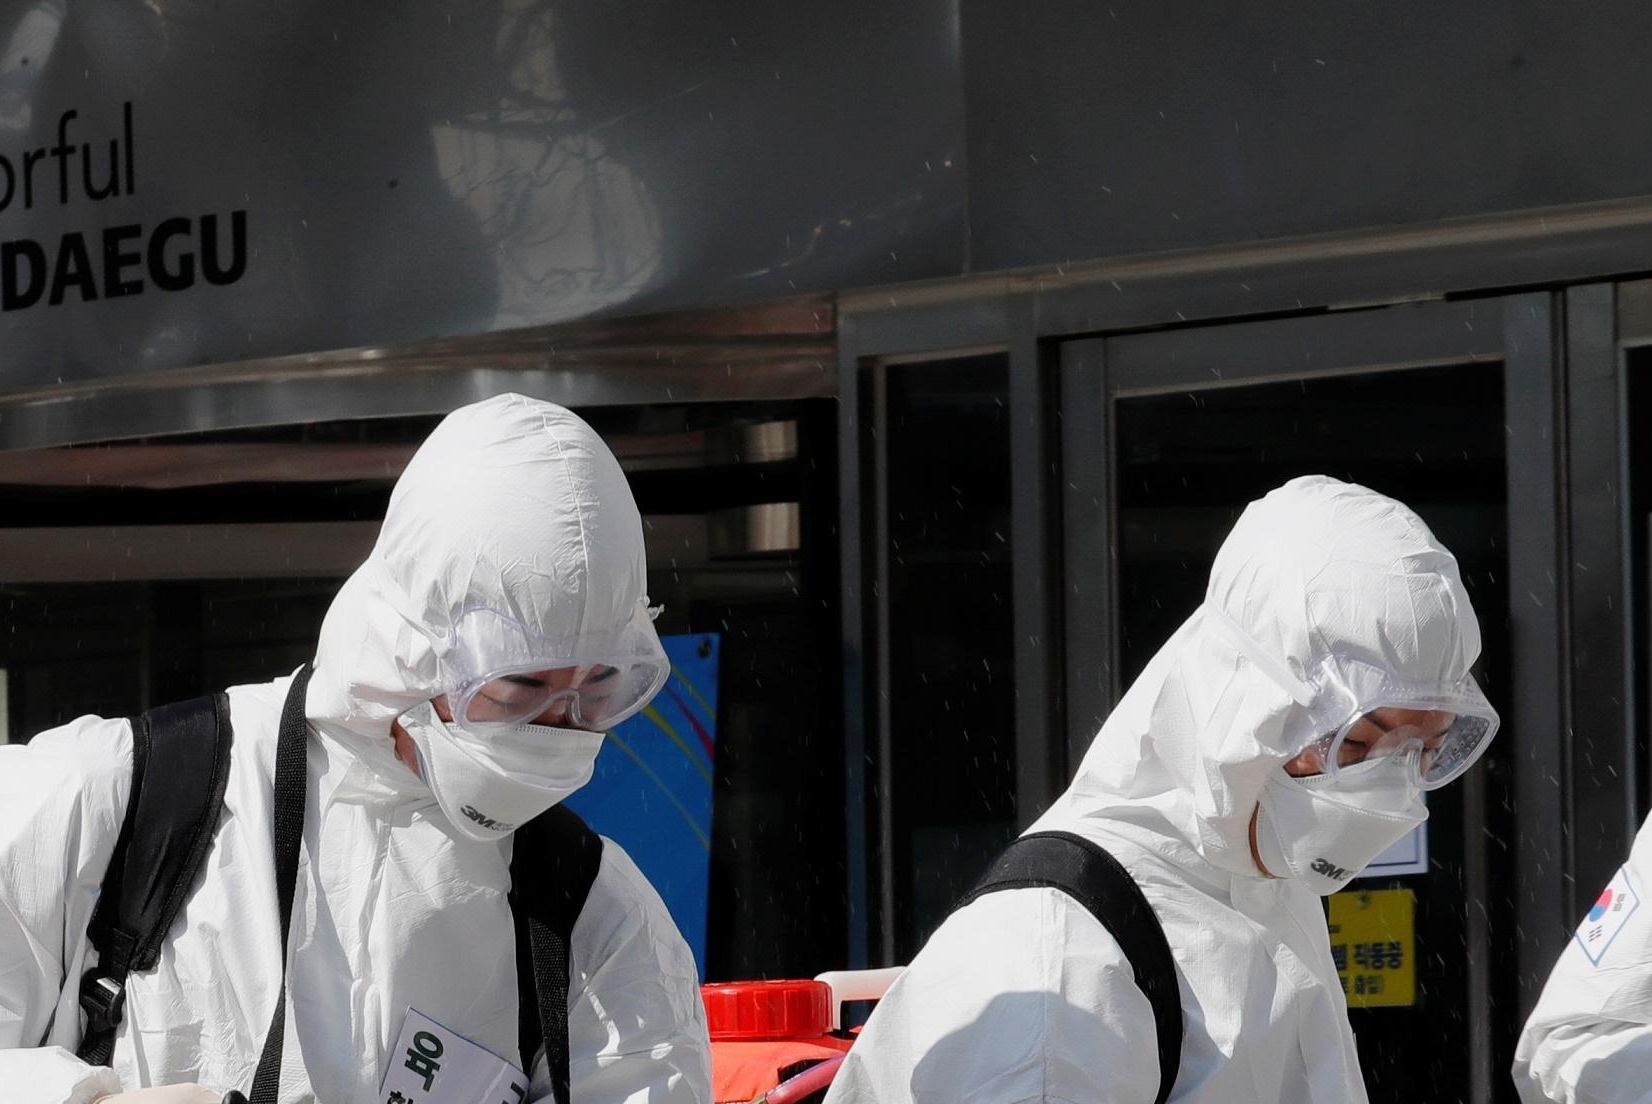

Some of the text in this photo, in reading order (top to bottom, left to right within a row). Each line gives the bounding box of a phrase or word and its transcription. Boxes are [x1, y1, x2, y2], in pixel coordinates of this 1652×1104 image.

[0, 210, 247, 312] DAEGU
[460, 804, 497, 828] 3M
[1310, 858, 1346, 880] 3M
[404, 1031, 444, 1092] 육
